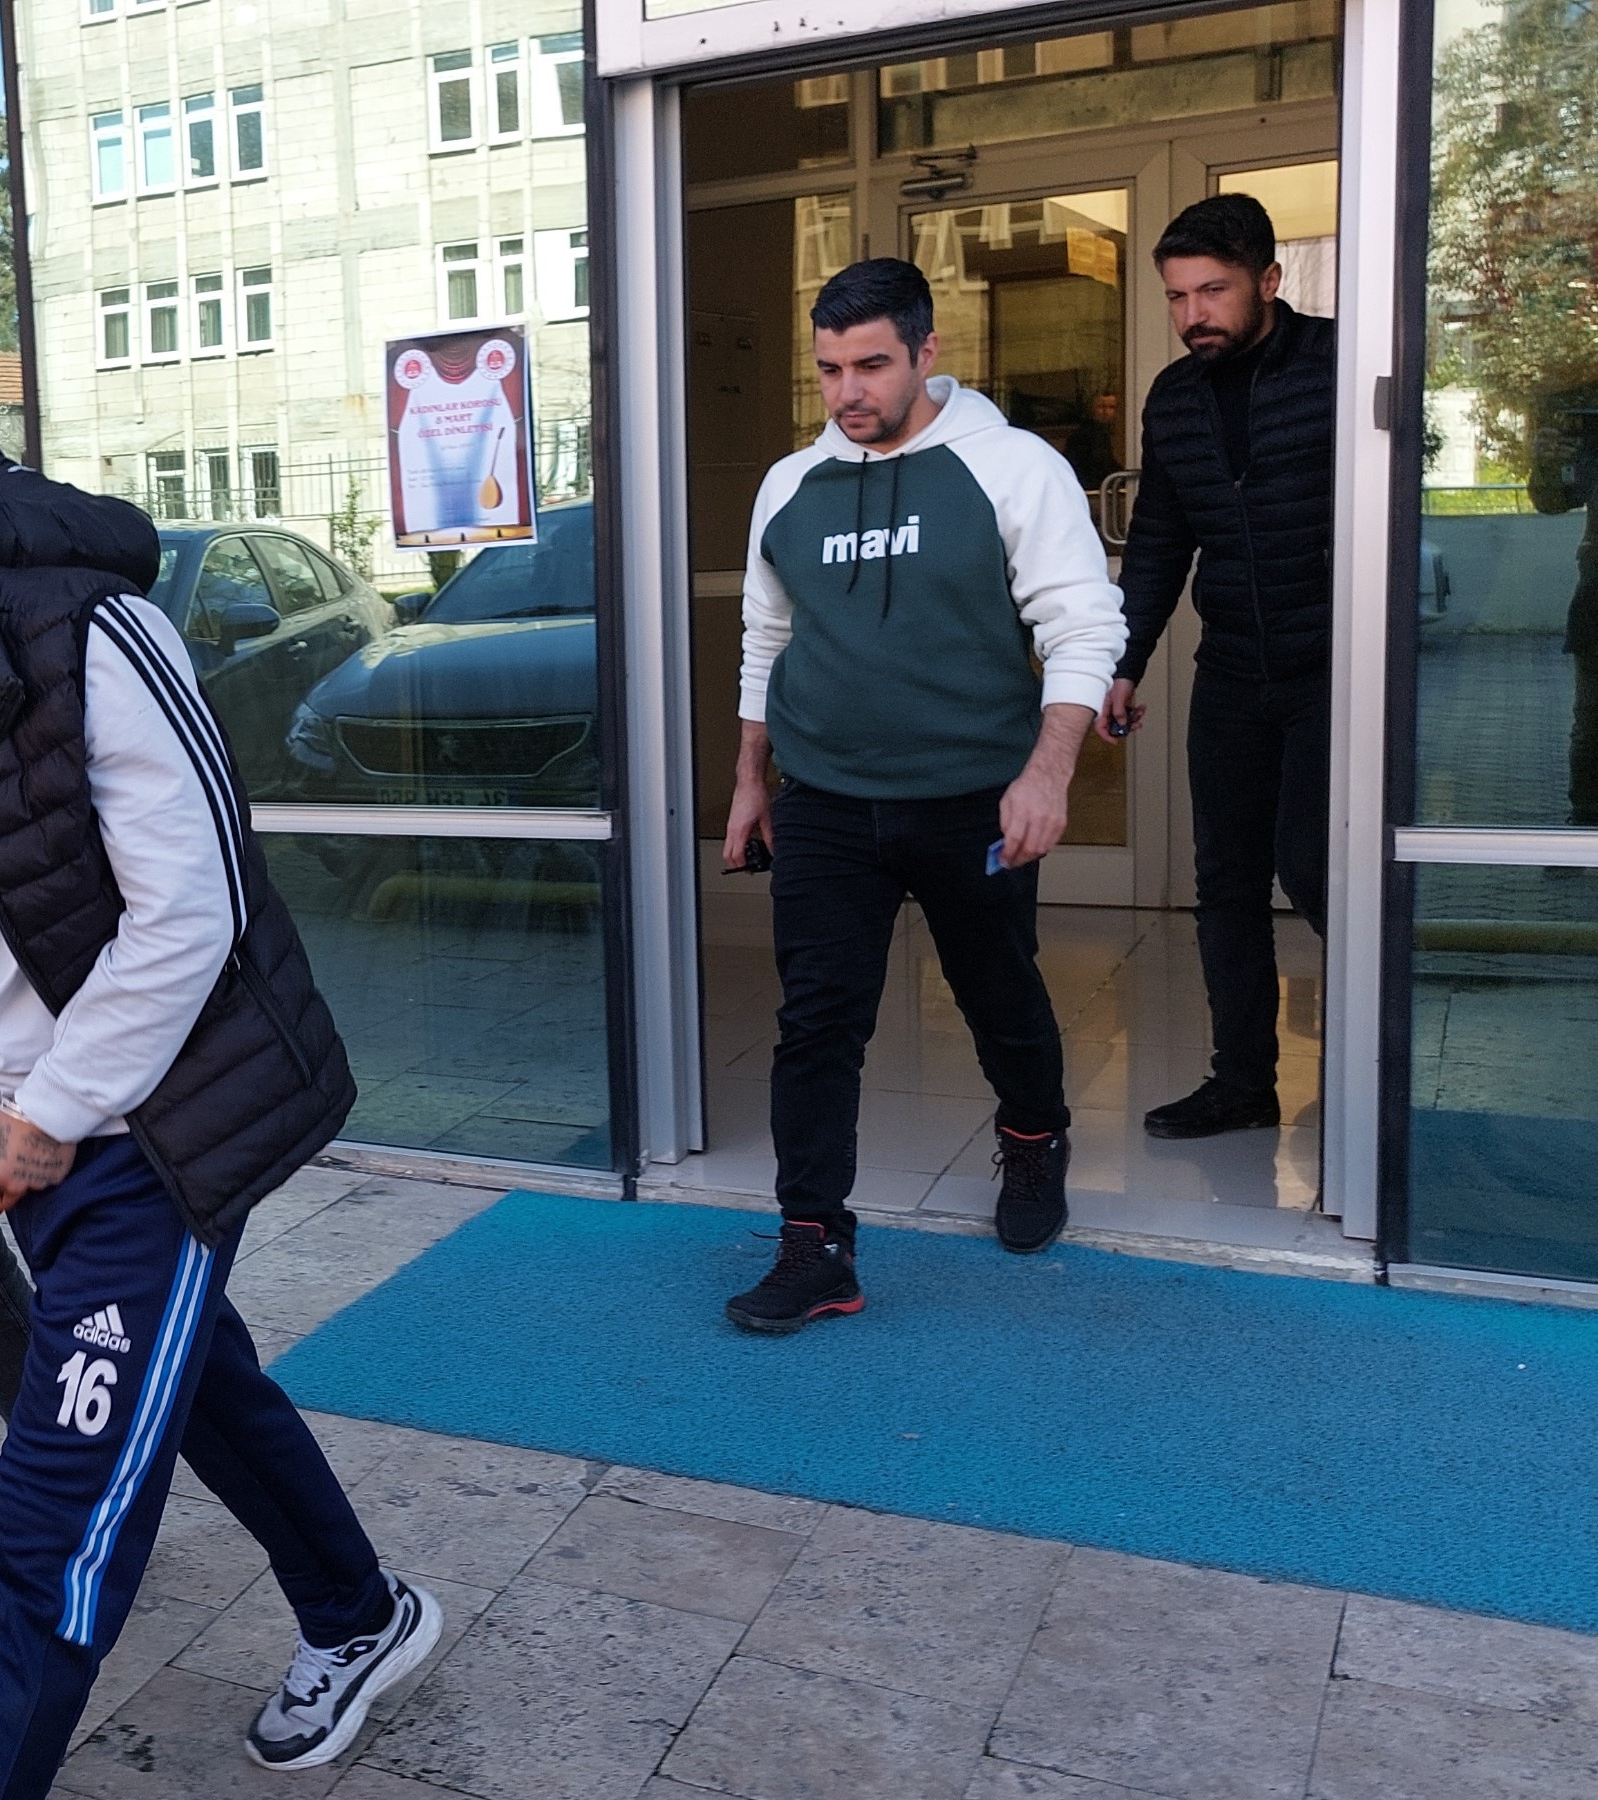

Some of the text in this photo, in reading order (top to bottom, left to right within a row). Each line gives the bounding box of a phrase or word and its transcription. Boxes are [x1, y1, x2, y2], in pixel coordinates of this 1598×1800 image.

[444, 413, 473, 423] MART
[822, 515, 920, 564] mavi
[73, 1323, 132, 1354] adidas
[56, 1350, 118, 1436] 16
